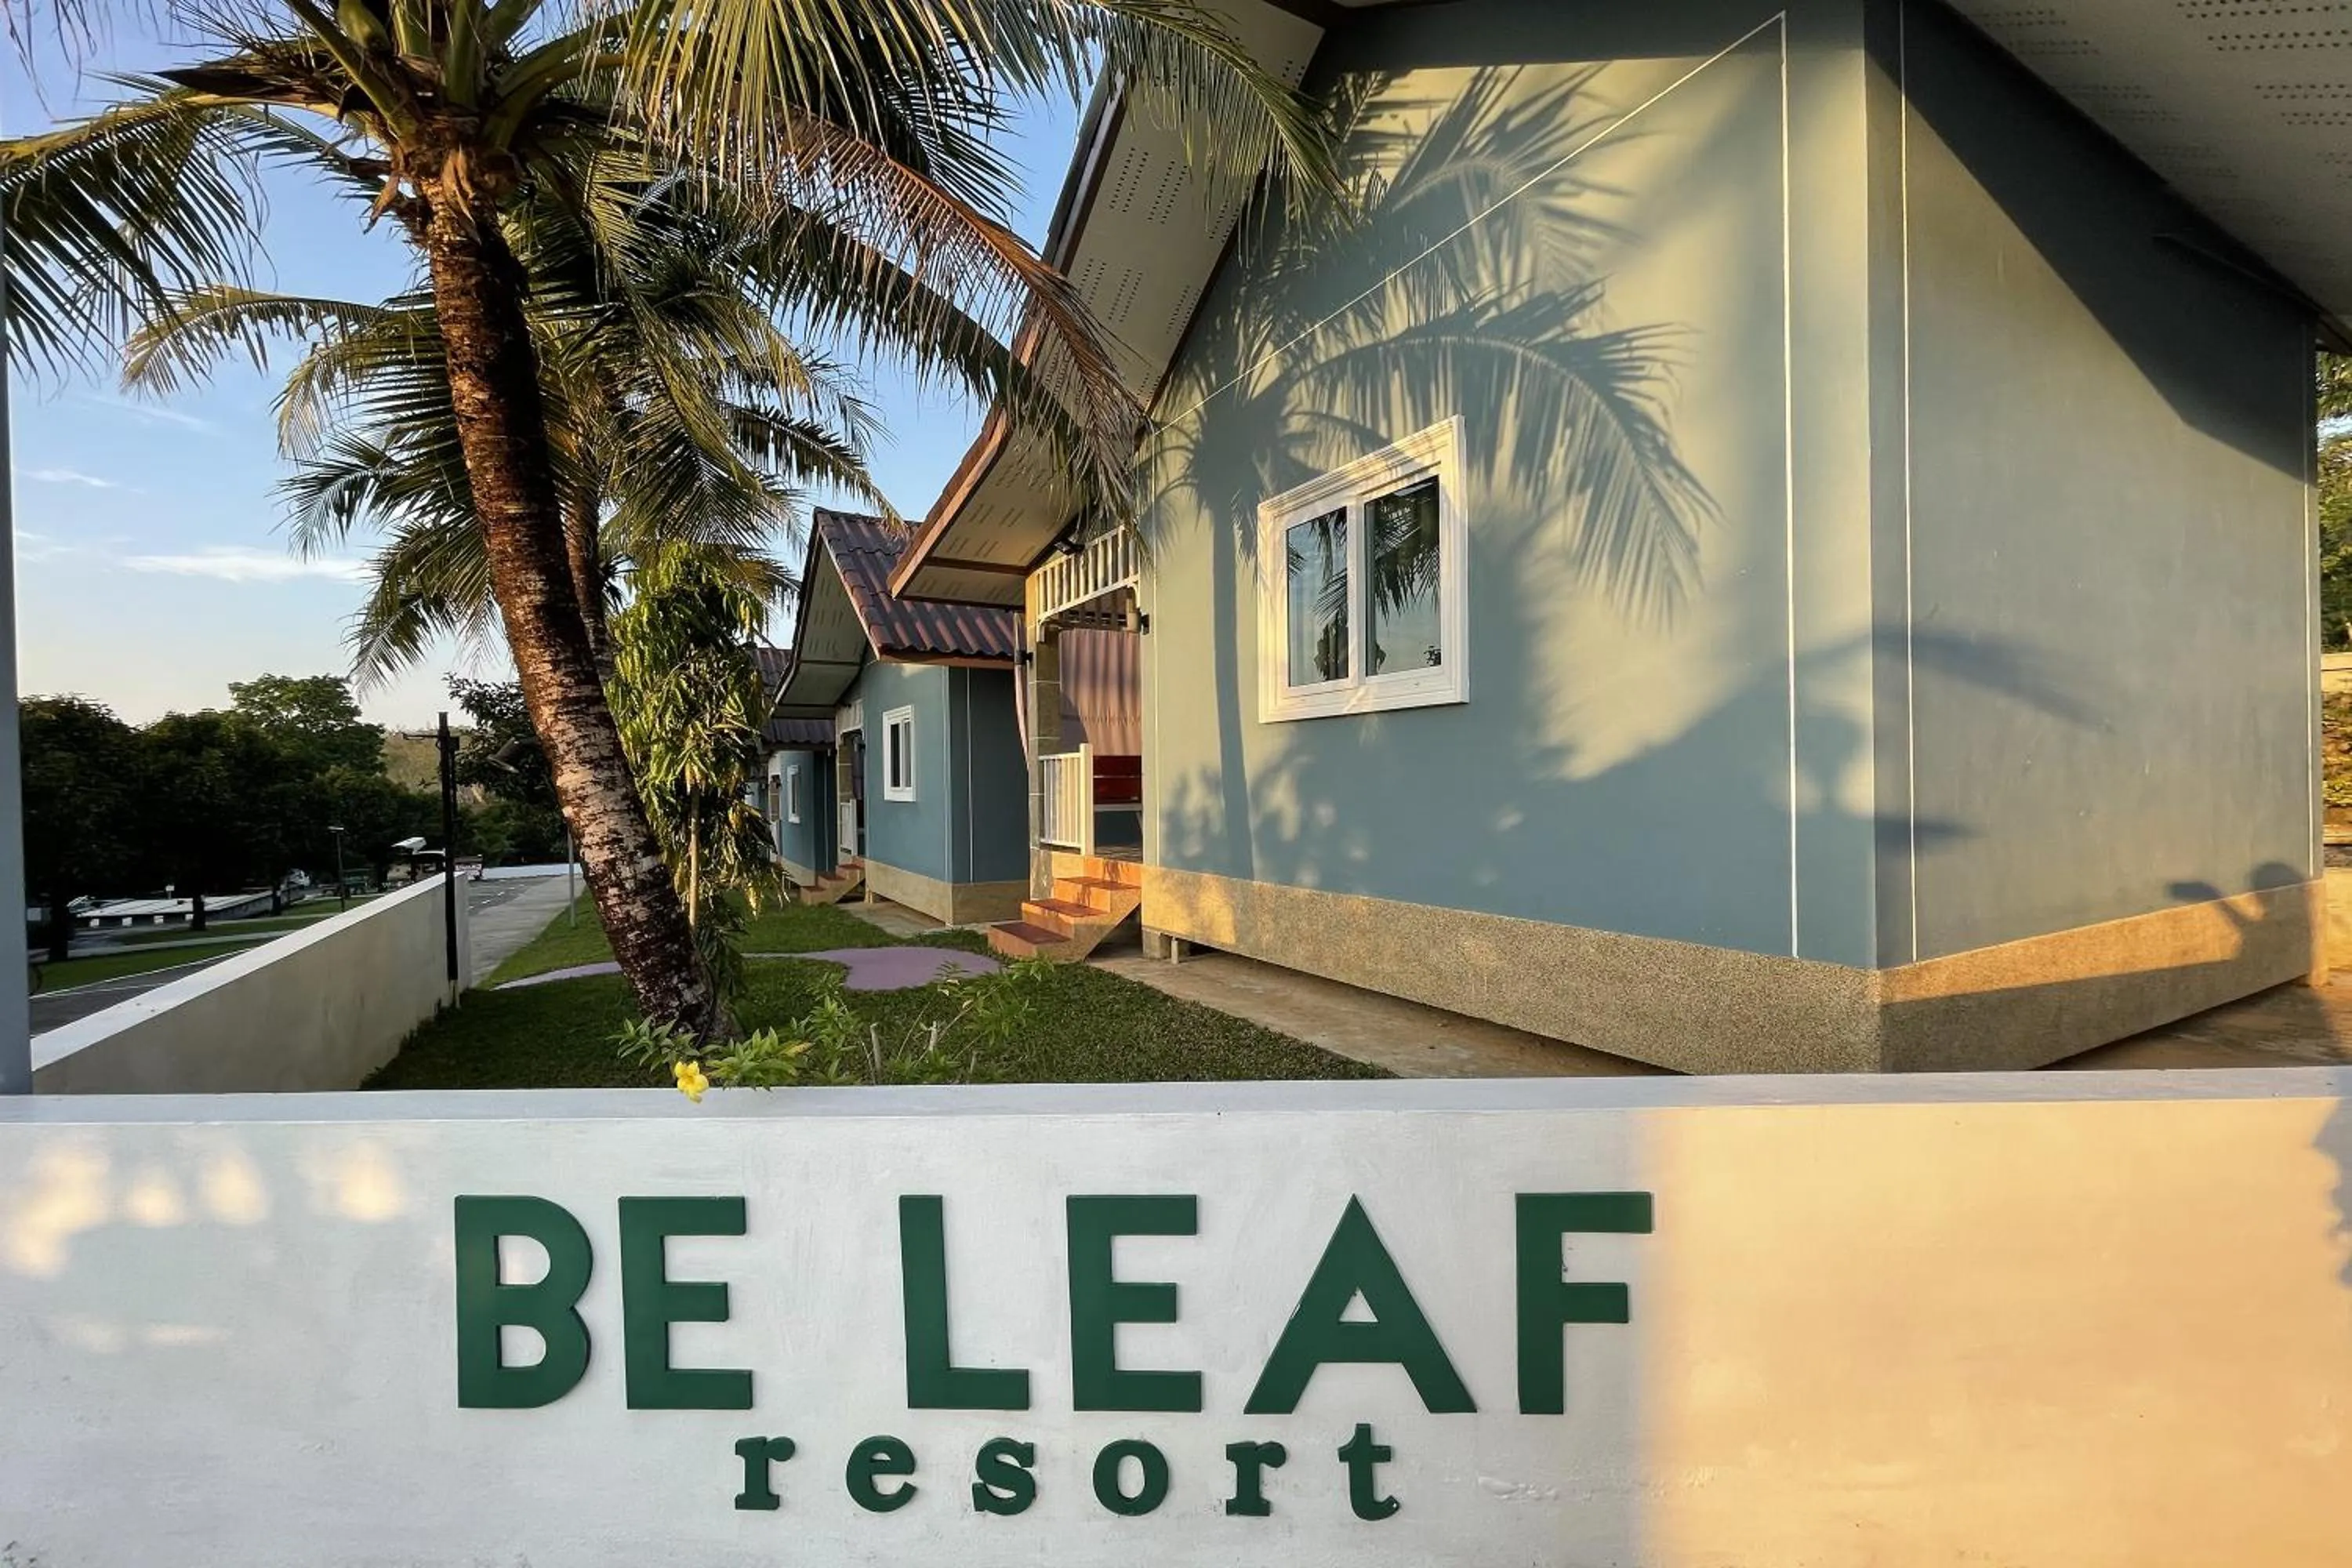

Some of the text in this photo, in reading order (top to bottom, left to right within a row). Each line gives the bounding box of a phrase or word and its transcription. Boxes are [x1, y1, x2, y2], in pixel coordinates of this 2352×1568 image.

[456, 1192, 1653, 1414] BE LEAF
[735, 1423, 1399, 1520] resort
